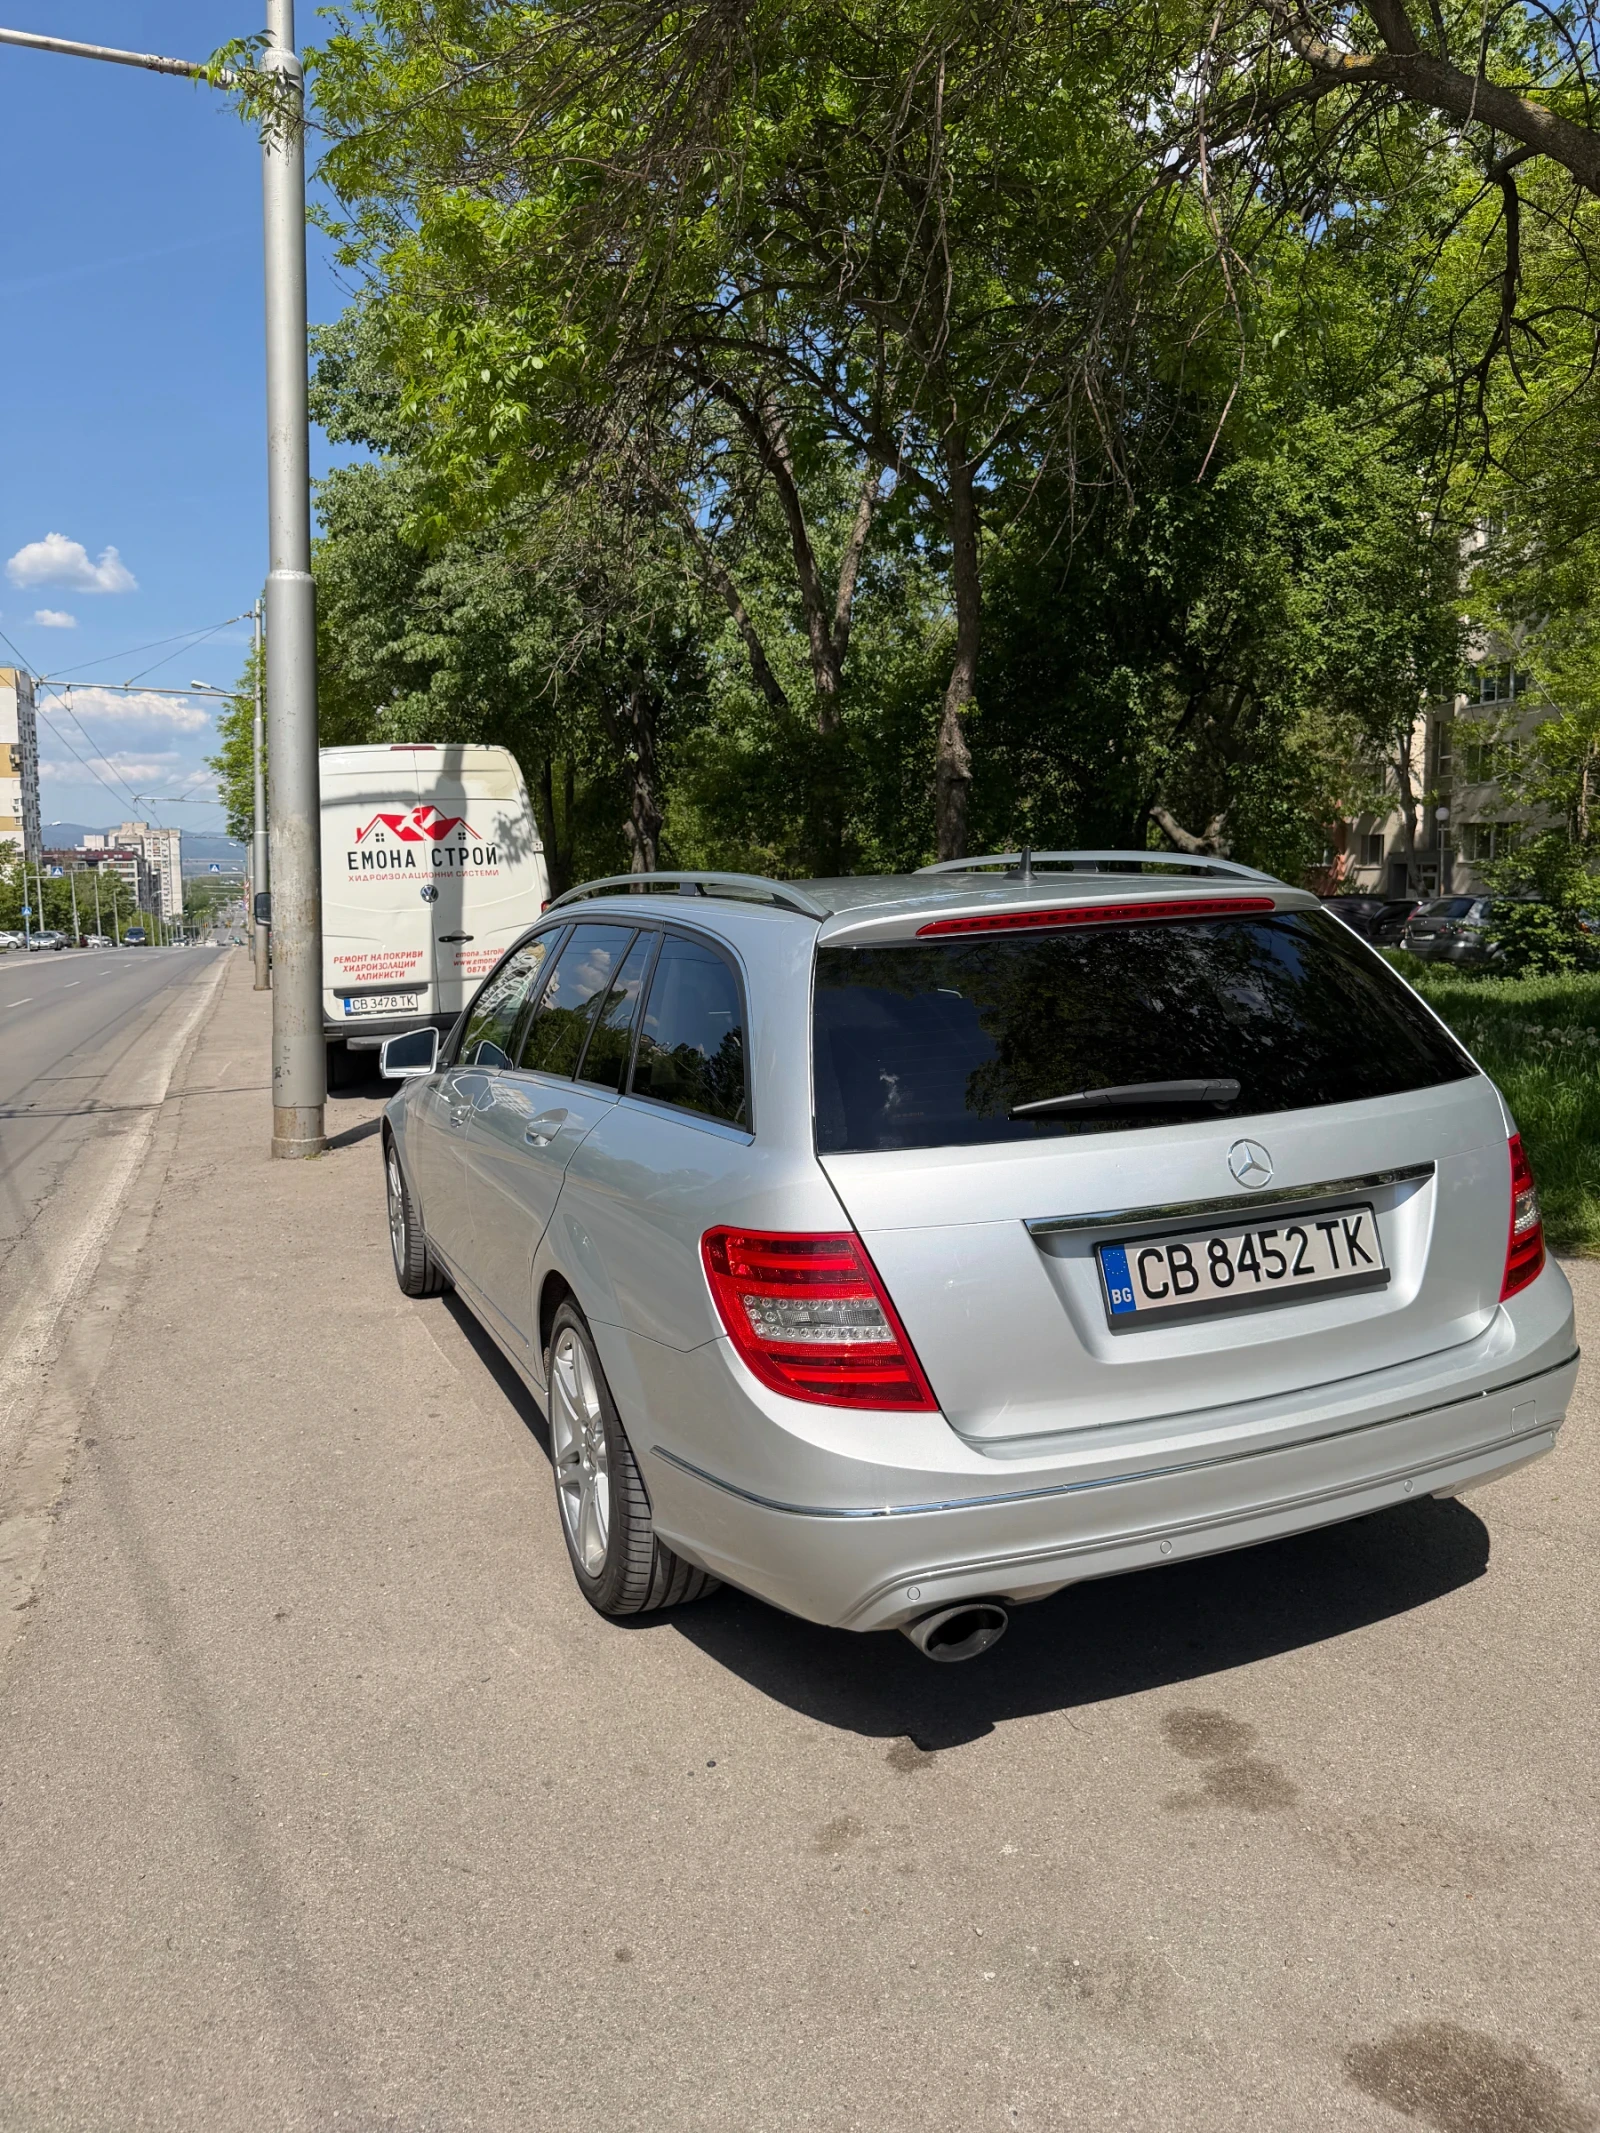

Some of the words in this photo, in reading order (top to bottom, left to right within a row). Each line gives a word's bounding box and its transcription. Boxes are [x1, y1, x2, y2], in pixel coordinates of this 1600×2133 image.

[347, 849, 416, 870] ЕМОНА
[431, 842, 498, 867] СТРОЙ
[348, 871, 454, 882] ХИДРОИЗОЛАЦИОННИ
[456, 869, 500, 878] СИСТЕМИ
[333, 954, 368, 964] РЕМОНТ
[370, 953, 382, 962] НА
[383, 950, 424, 960] ПОКРИВИ
[342, 960, 416, 973] ХИДРОИЗОЛАЦИИ
[355, 970, 406, 981] АЛПИНИСТИ
[352, 999, 368, 1010] CB
[370, 996, 398, 1009] 3478
[400, 995, 415, 1007] TK
[1136, 1243, 1200, 1300] CB
[1206, 1226, 1315, 1289] 8452
[1315, 1215, 1375, 1270] TK
[1111, 1287, 1133, 1305] BG
